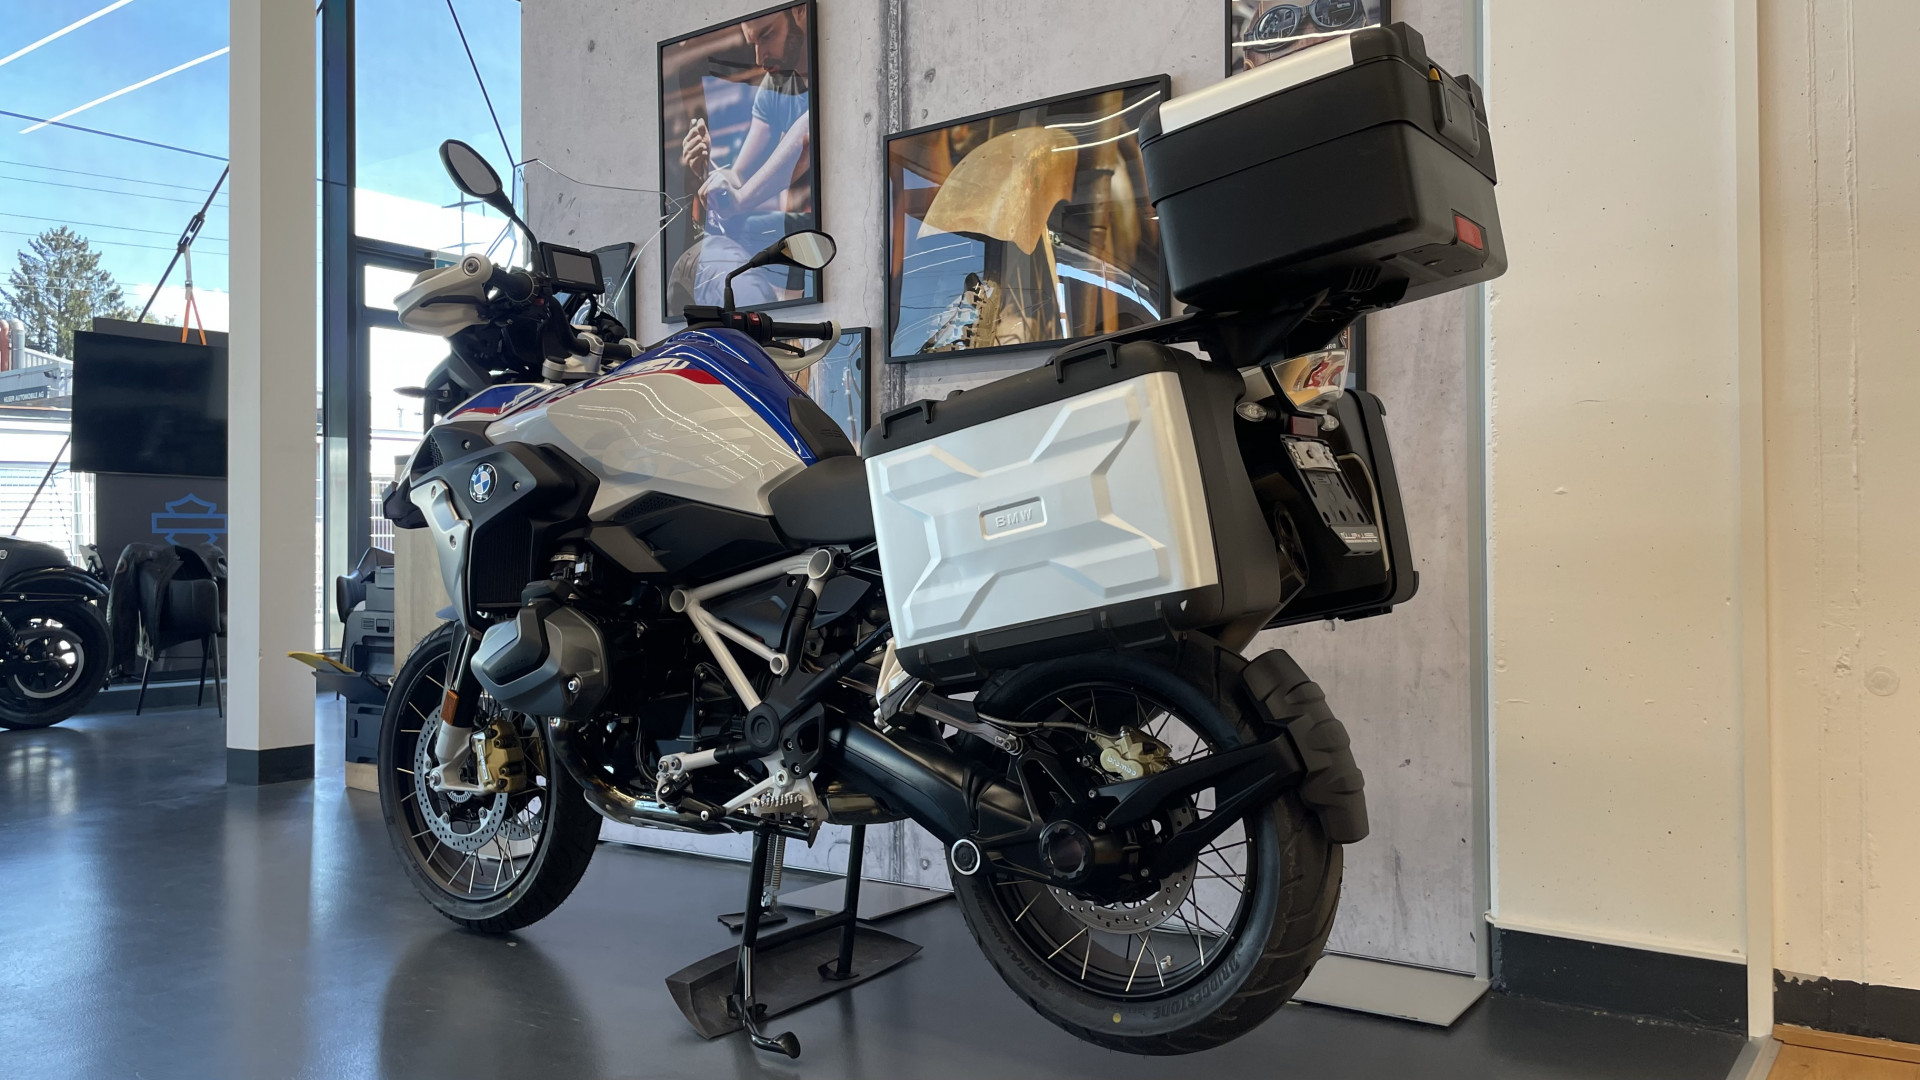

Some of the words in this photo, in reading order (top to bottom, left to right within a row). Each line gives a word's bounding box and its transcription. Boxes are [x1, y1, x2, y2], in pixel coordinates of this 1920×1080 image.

[995, 508, 1033, 528] BMW
[1106, 754, 1137, 776] brembo
[1151, 954, 1241, 1019] BRIDGESTONE
